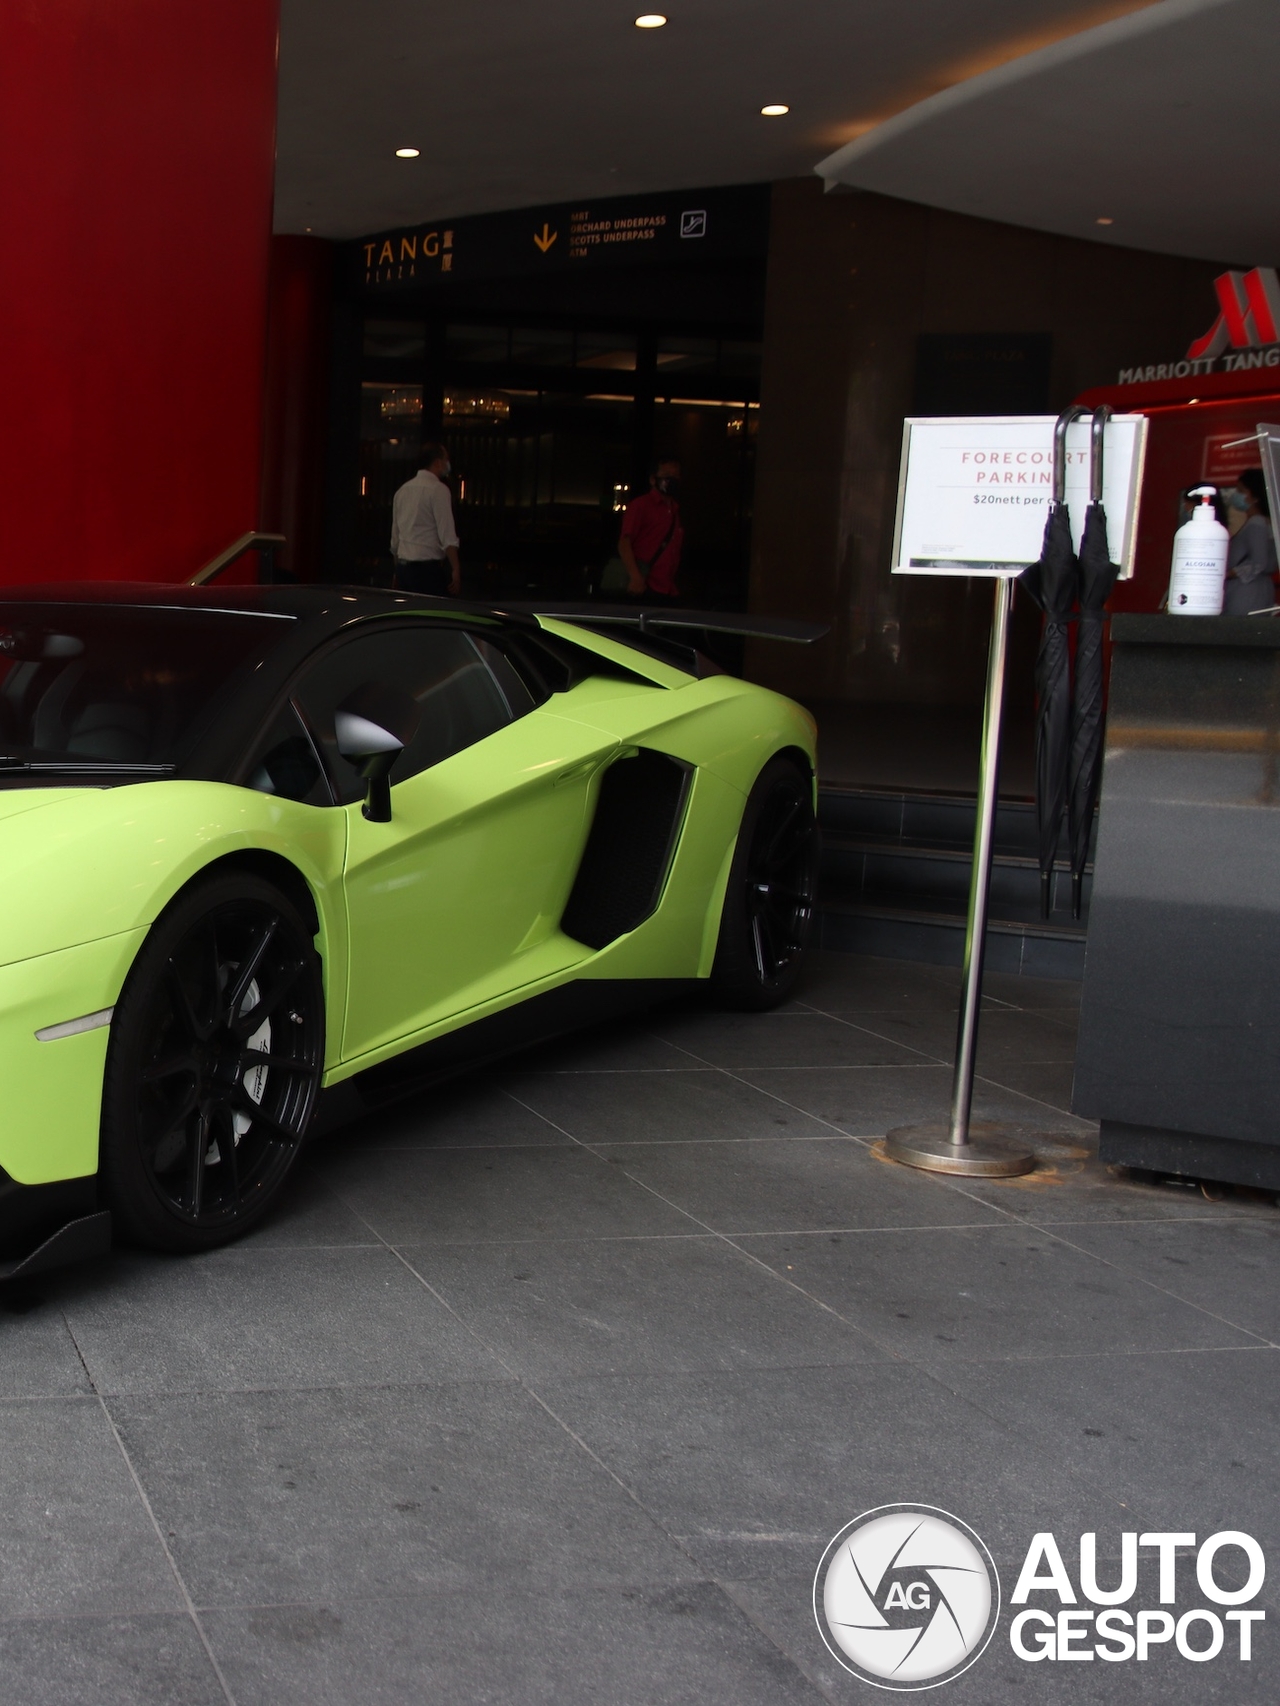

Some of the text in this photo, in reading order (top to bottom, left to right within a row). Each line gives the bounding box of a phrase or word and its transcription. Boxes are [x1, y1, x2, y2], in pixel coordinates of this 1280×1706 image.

[570, 215, 667, 233] ORCHARD UNDERPASS
[570, 228, 655, 246] SCOTTS UNDERPASS
[363, 231, 439, 267] TANG
[569, 247, 588, 258] ATM
[365, 263, 416, 284] PLAZA
[1118, 348, 1280, 386] MARRIOTT TANG
[976, 472, 1053, 484] PARKIN
[973, 494, 1021, 505] $20nett
[1023, 496, 1044, 506] per
